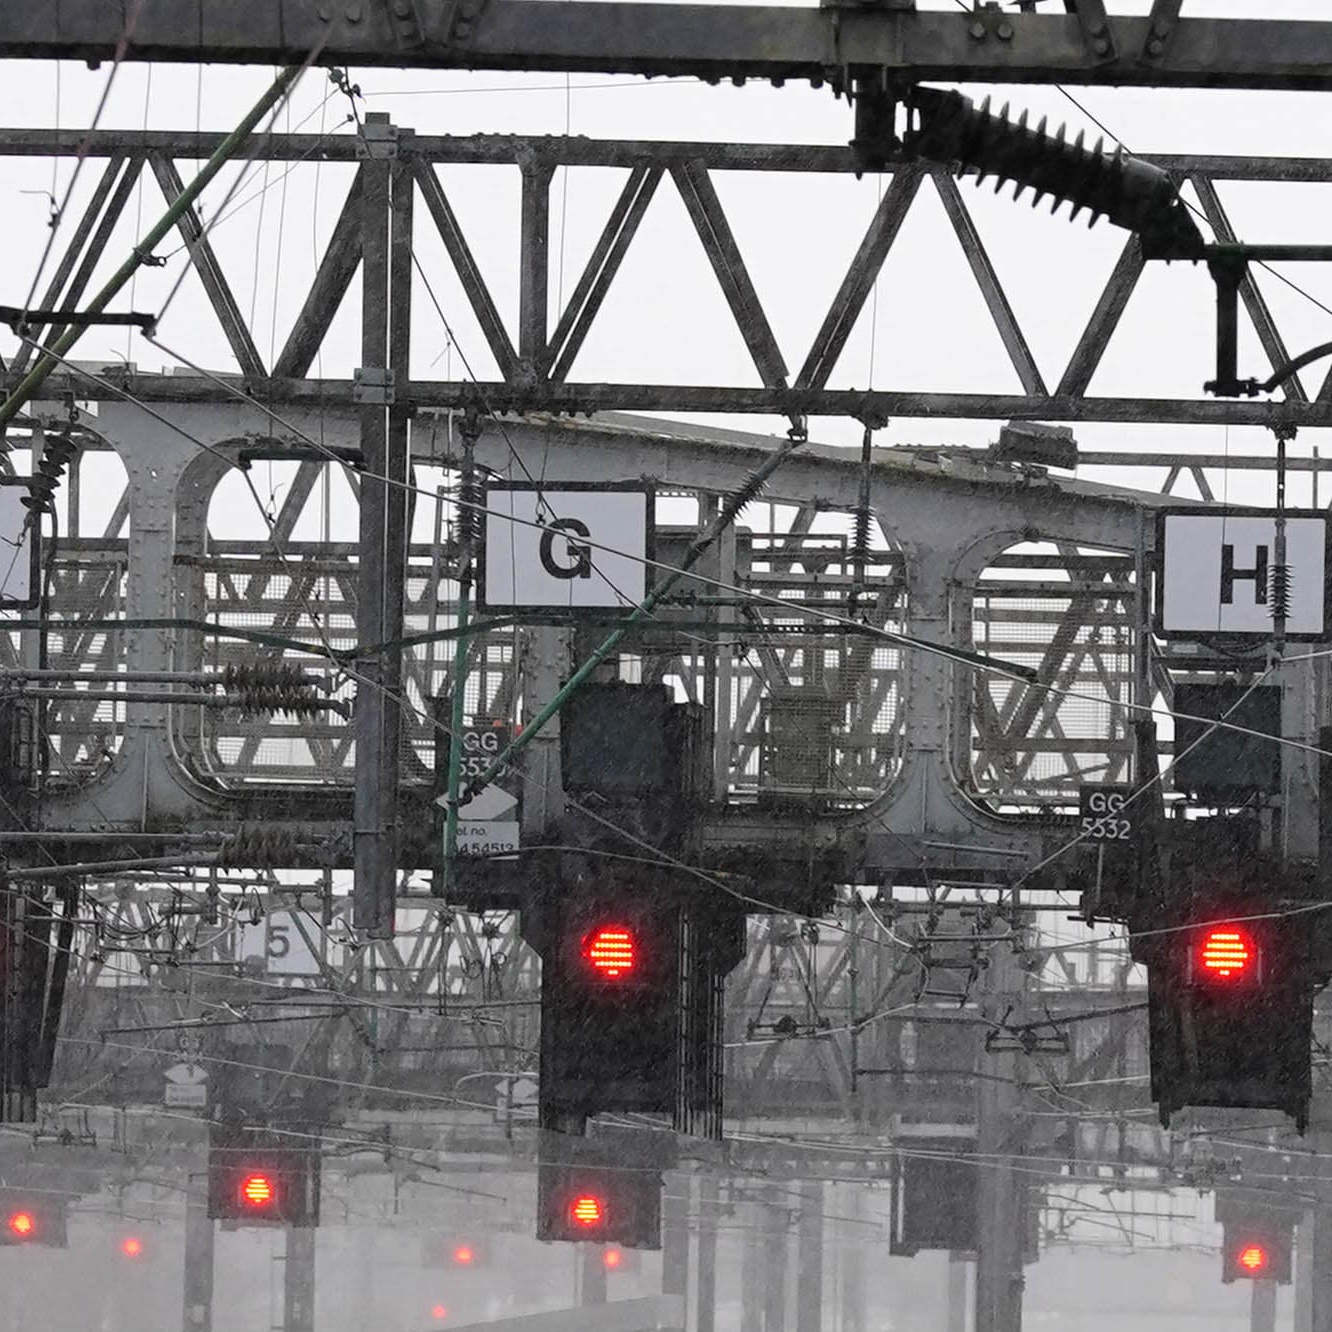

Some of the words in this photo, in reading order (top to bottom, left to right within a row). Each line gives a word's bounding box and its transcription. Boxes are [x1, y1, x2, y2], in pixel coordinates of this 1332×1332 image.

[539, 517, 592, 580] G
[1220, 544, 1268, 605] H
[463, 731, 498, 751] GG
[1089, 792, 1124, 812] GG
[1082, 817, 1131, 839] 5532
[267, 926, 290, 958] 5
